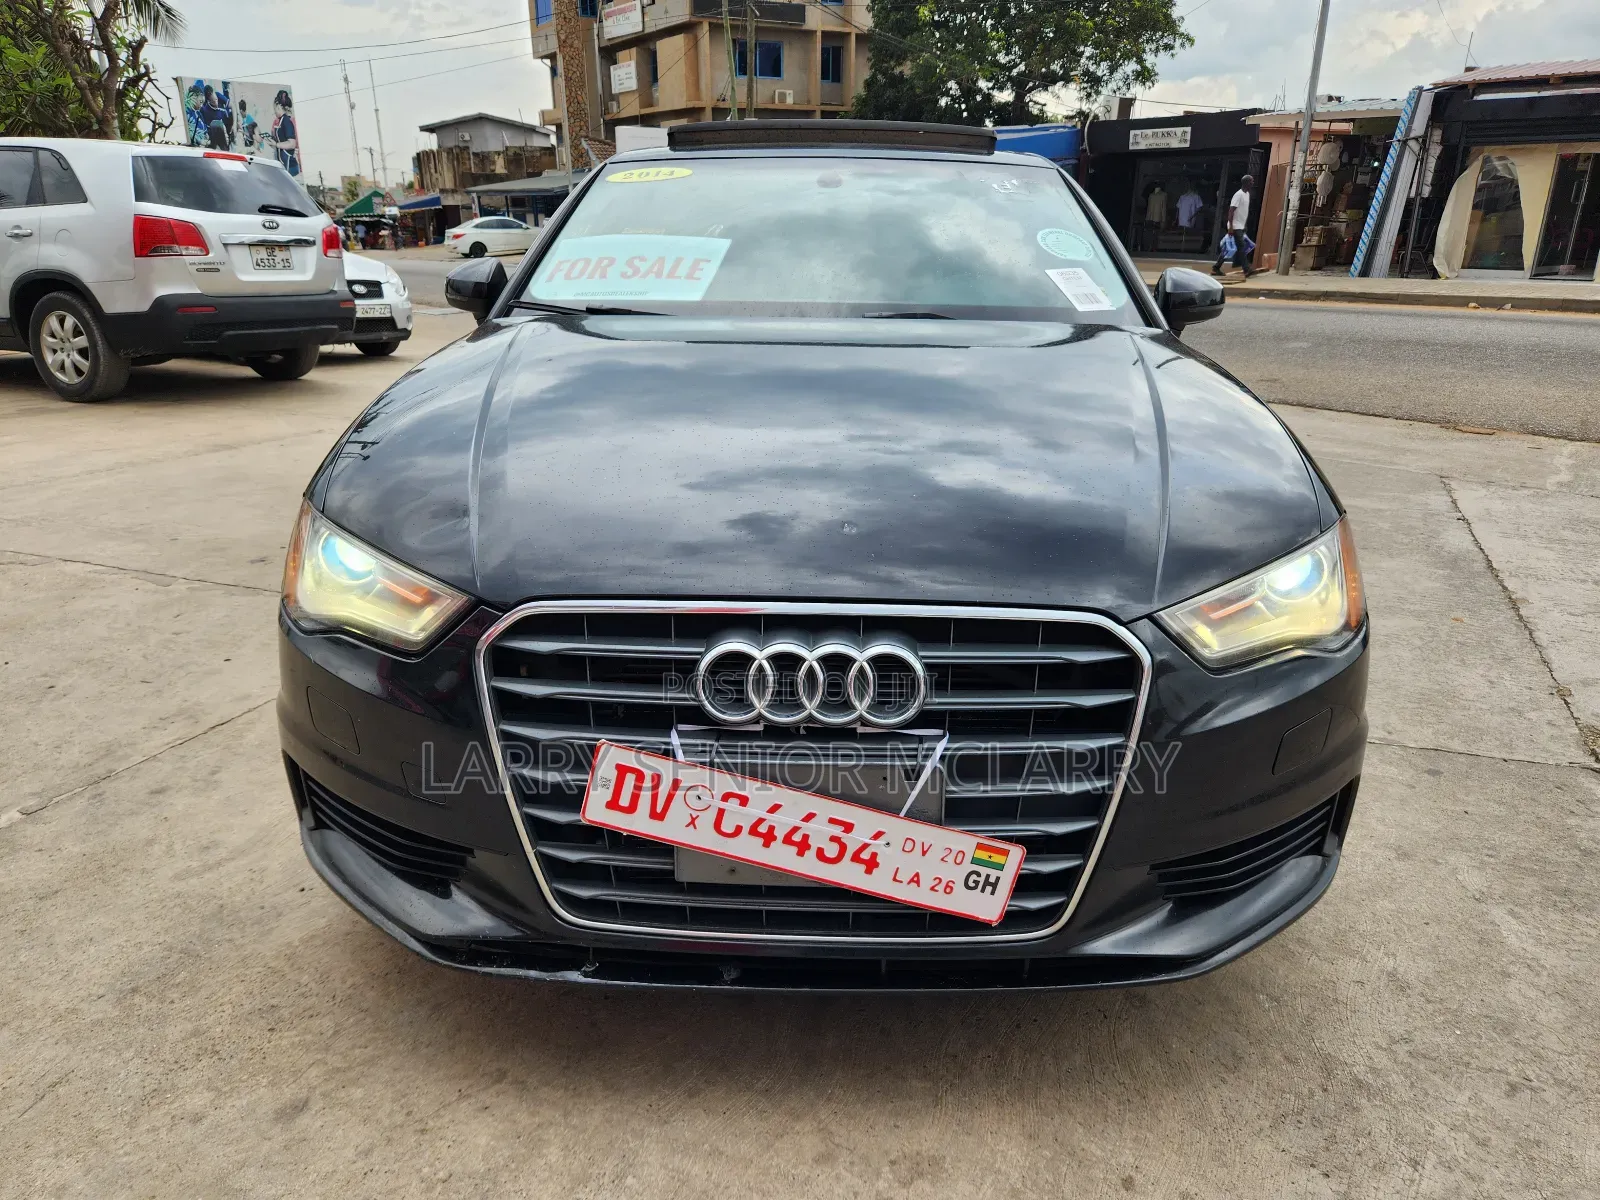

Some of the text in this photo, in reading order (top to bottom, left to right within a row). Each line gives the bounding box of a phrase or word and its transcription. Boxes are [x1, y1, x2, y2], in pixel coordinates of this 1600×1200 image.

[622, 170, 675, 179] 2014
[264, 221, 278, 229] KIA
[255, 258, 291, 268] 4533-15
[265, 247, 277, 257] GE
[545, 255, 711, 283] FOR SALE
[605, 763, 886, 875] DV C4434
[902, 837, 965, 865] DV 20
[892, 867, 956, 894] LA 26
[963, 870, 1000, 896] GH
